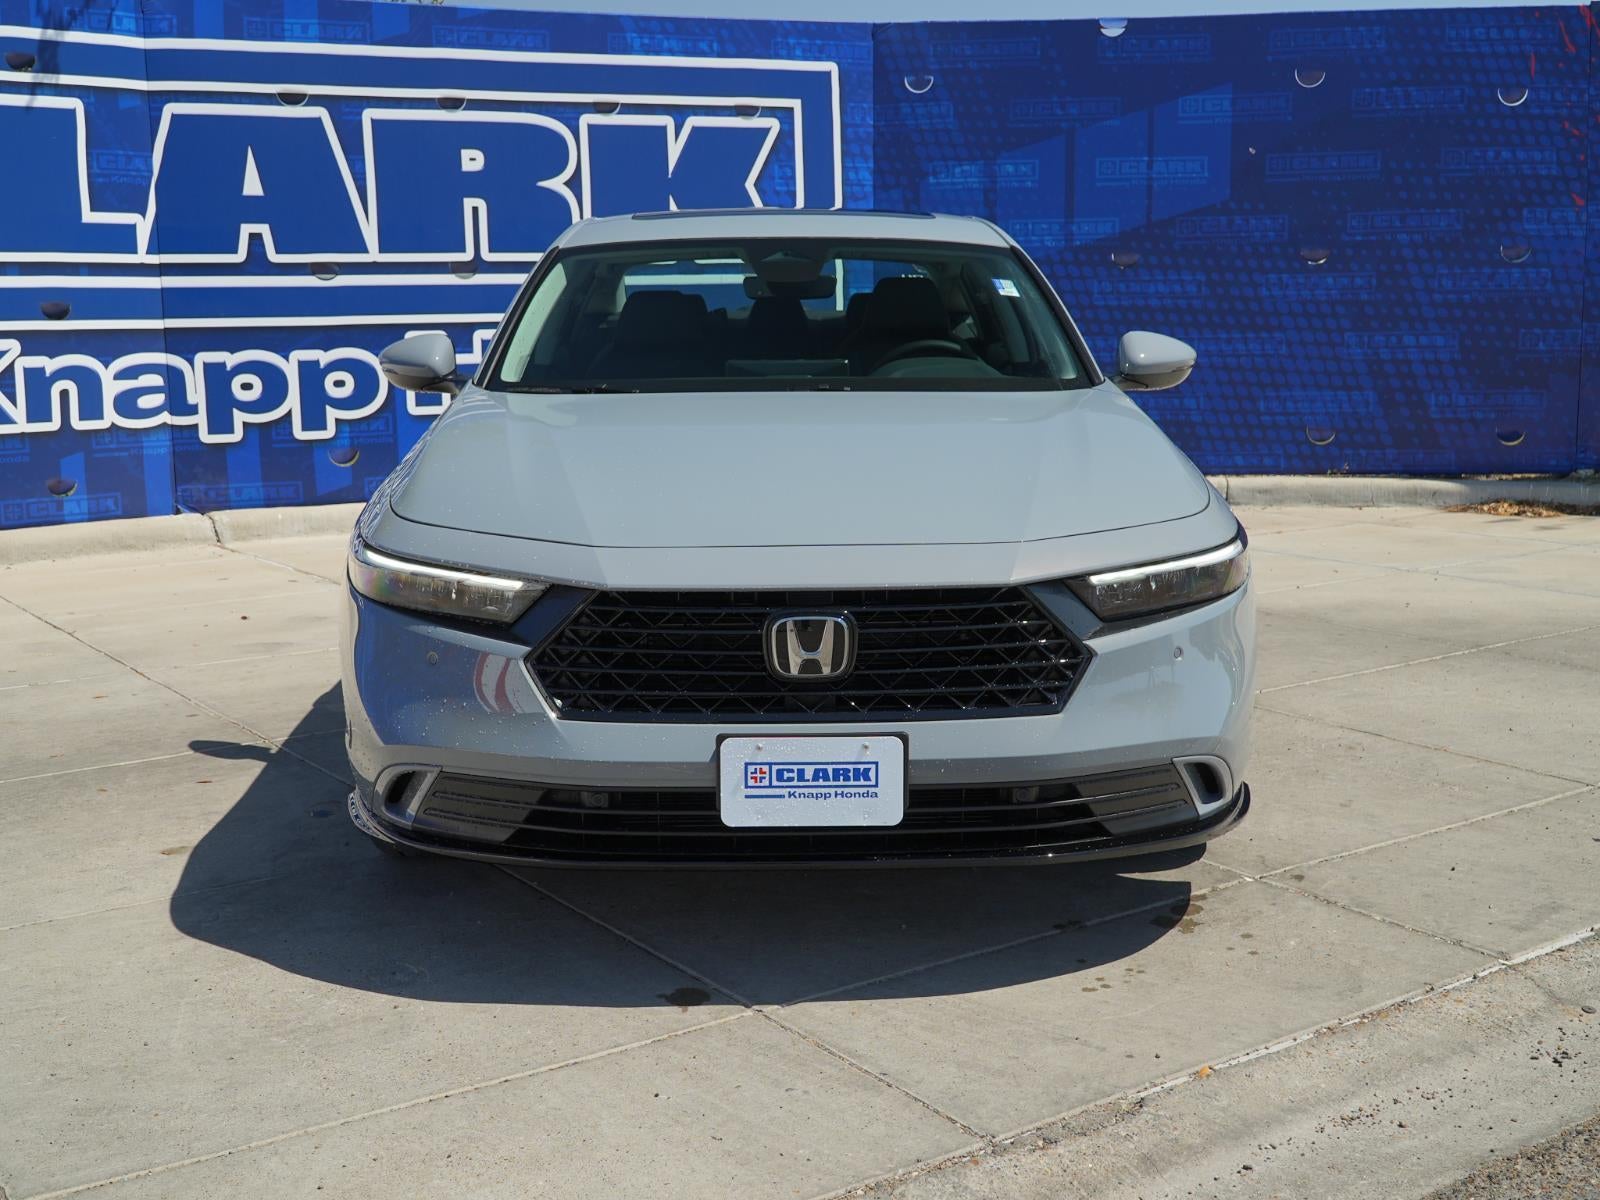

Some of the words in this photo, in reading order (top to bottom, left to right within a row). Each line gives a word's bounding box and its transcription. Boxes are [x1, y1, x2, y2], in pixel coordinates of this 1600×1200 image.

[1118, 160, 1203, 175] CLARK
[0, 339, 389, 443] napp
[775, 767, 872, 783] CLARK
[787, 790, 832, 801] Knapp
[834, 789, 879, 799] Honda
